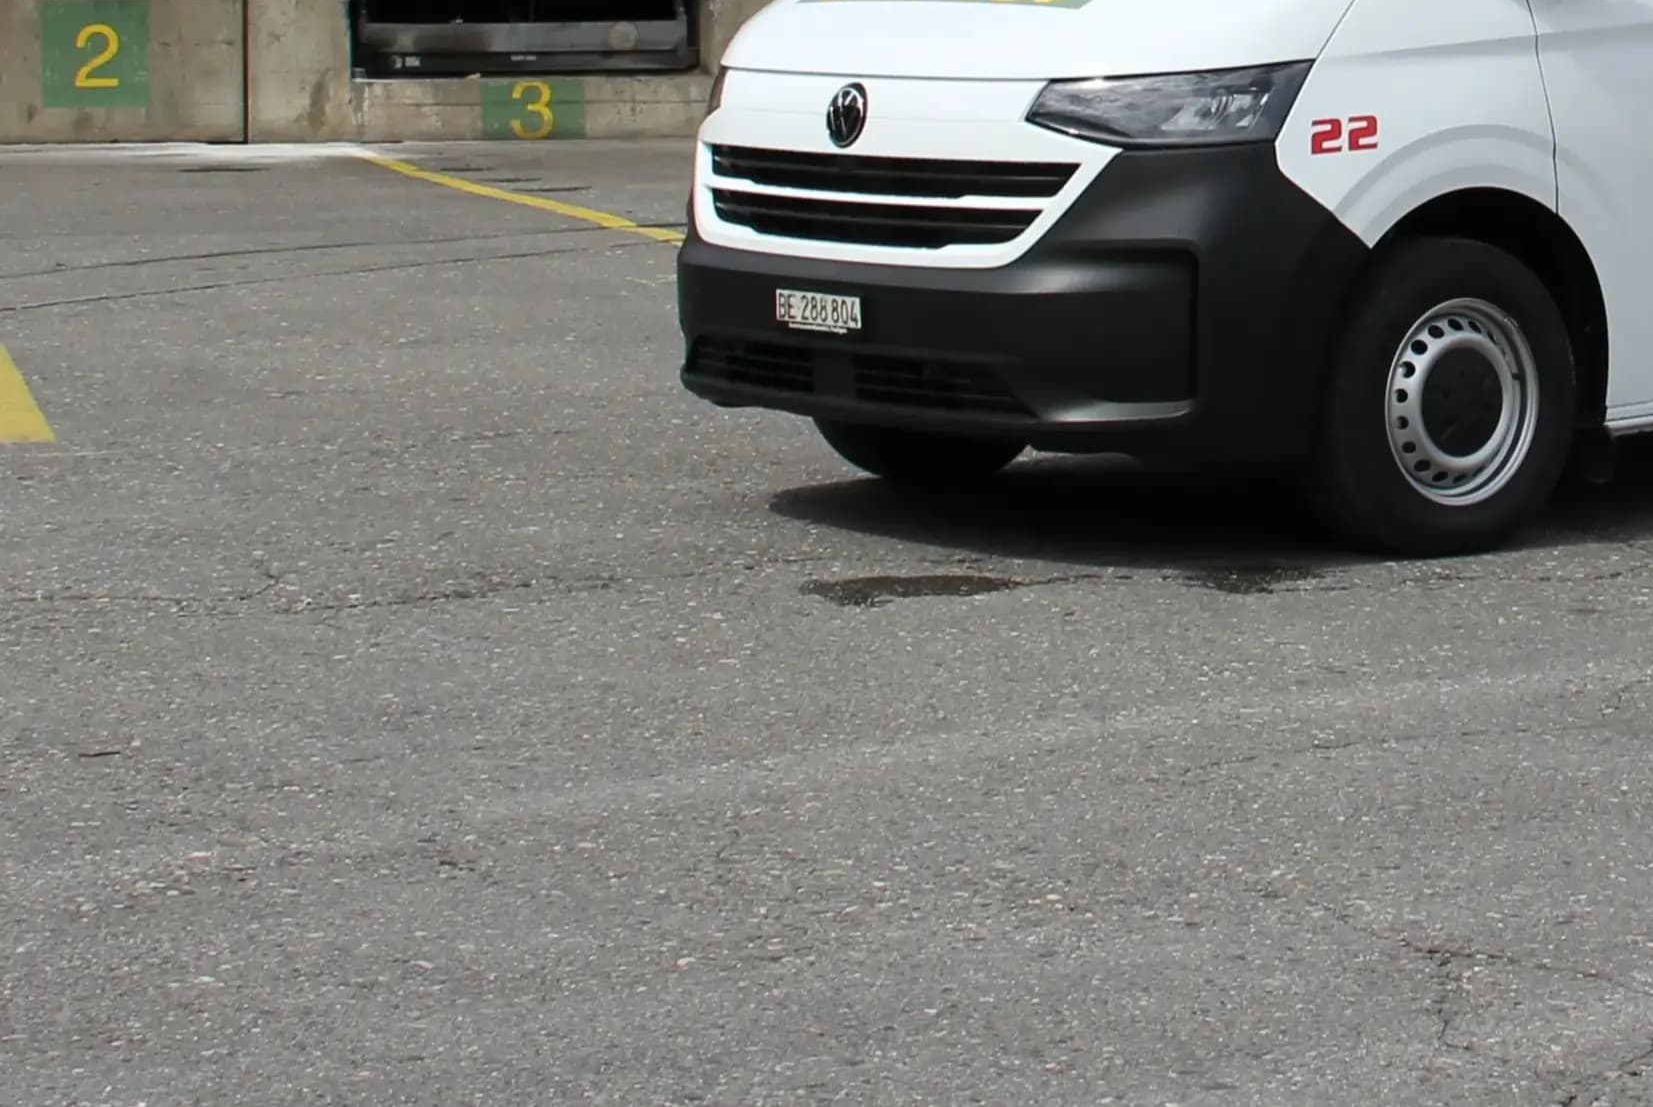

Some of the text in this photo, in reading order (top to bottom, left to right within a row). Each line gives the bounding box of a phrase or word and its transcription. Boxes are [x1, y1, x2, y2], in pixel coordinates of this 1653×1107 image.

[75, 23, 120, 87] 2
[510, 80, 554, 140] 3
[1311, 114, 1379, 155] 22
